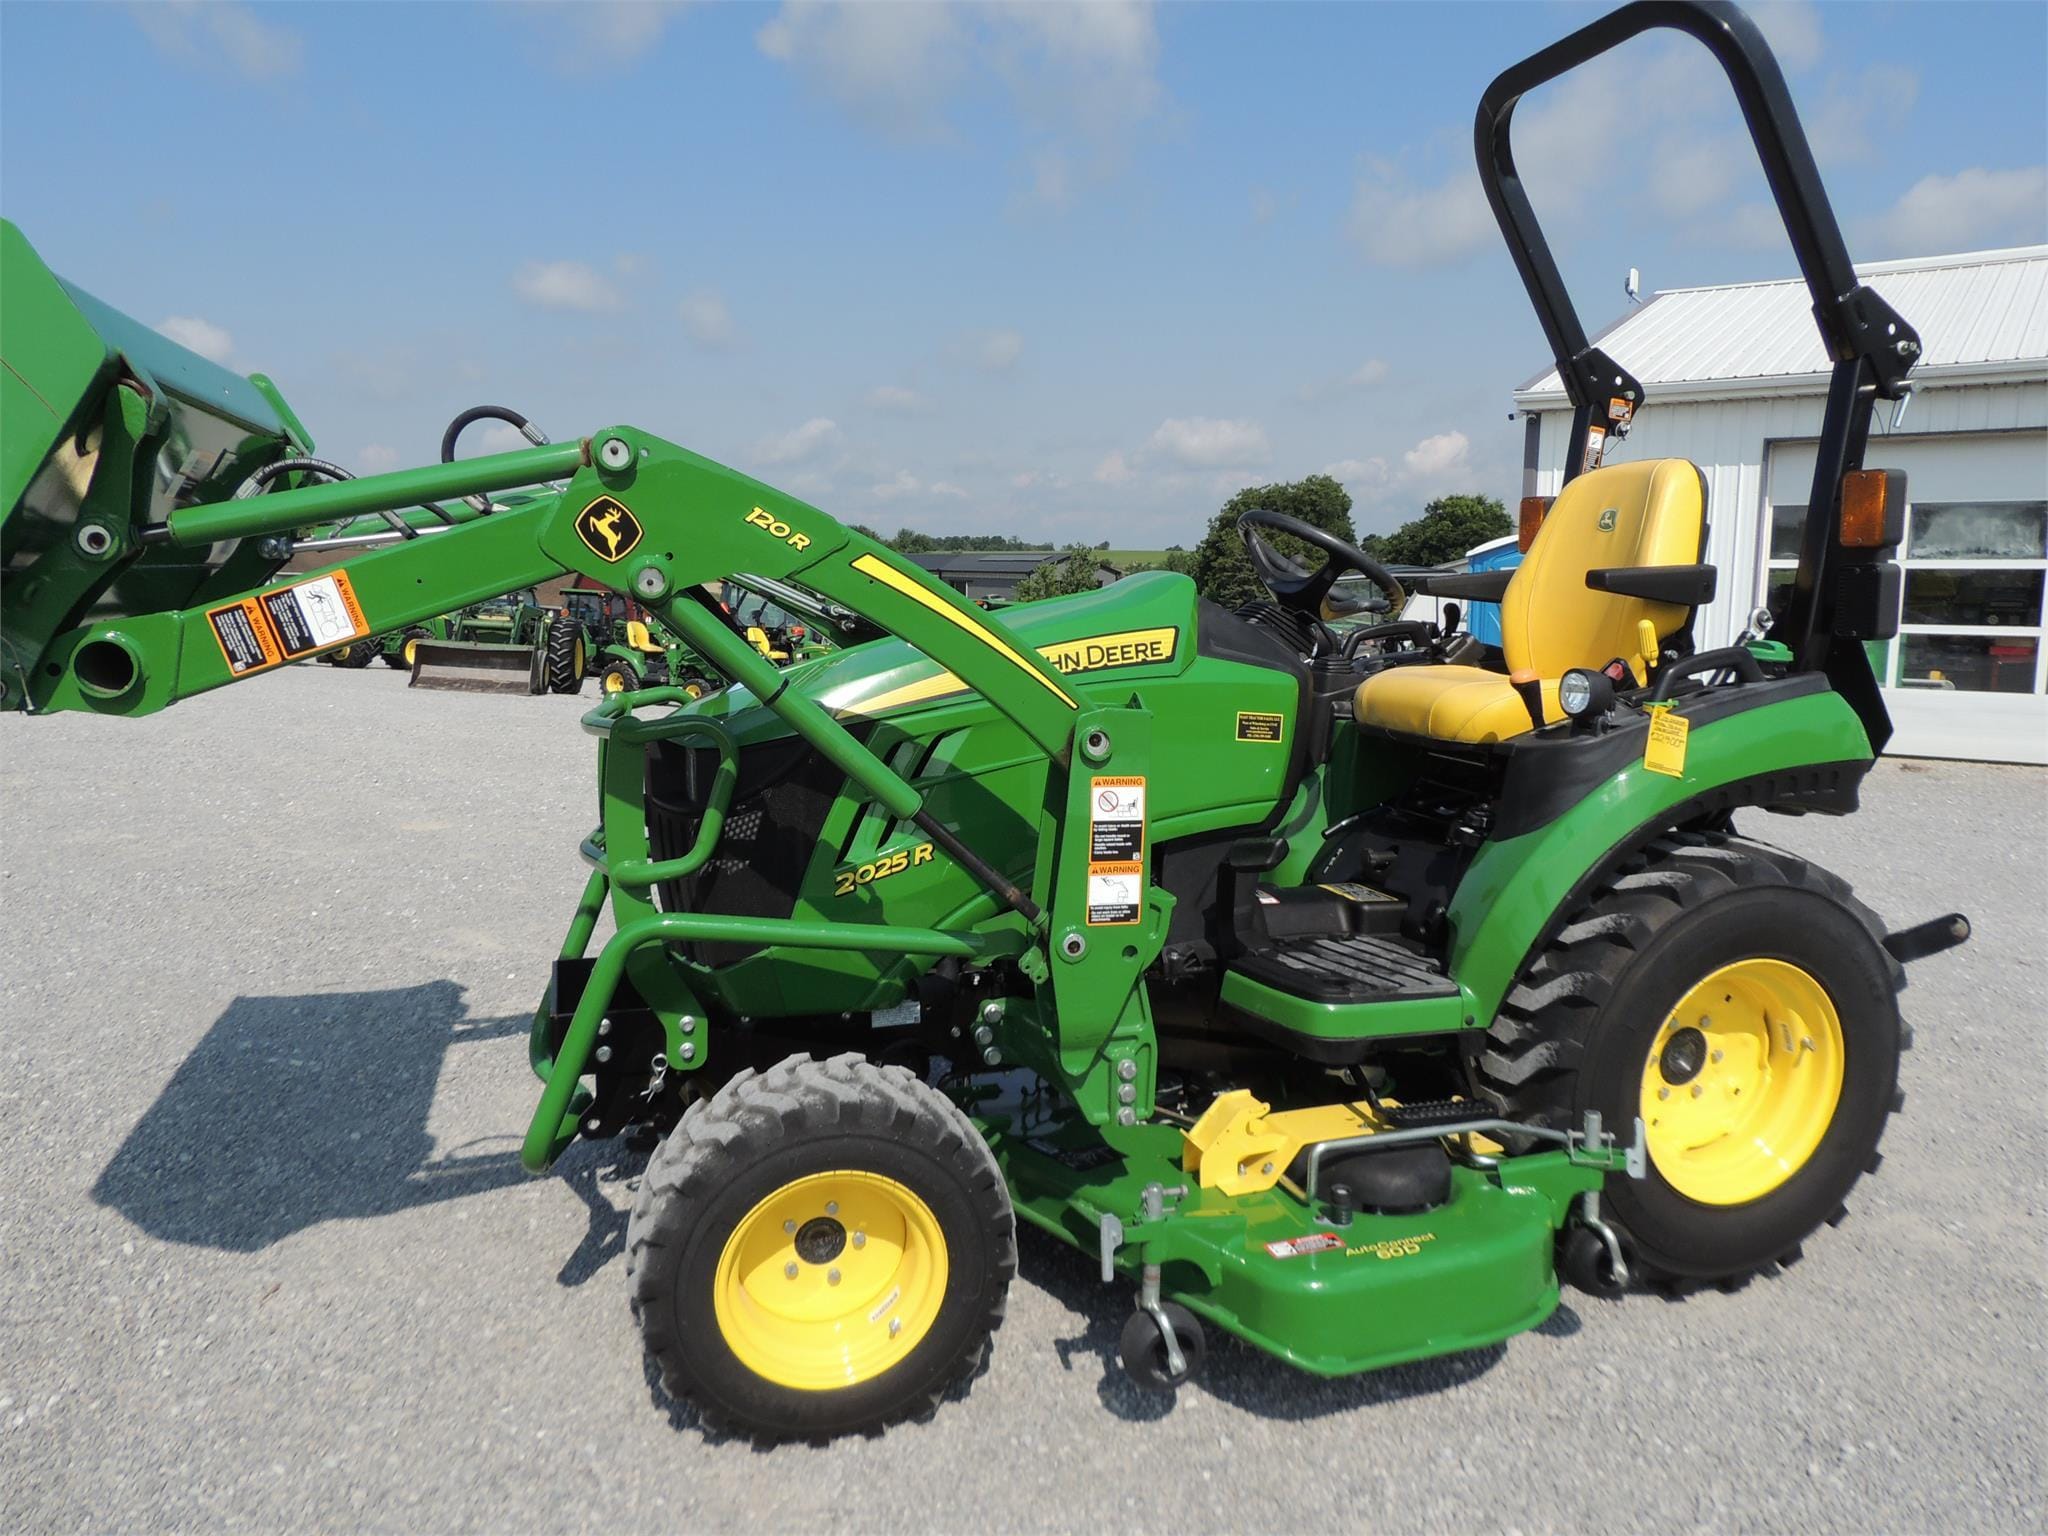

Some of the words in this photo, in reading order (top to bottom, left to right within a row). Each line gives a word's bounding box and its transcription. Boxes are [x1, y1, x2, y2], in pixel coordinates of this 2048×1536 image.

[744, 506, 791, 538] 120
[787, 532, 811, 552] R
[342, 587, 363, 628] WARNING
[252, 617, 275, 657] WARNING
[1047, 652, 1080, 669] HN
[1087, 641, 1163, 665] DEERE
[1102, 778, 1143, 787] WARNING
[834, 850, 909, 897] 2025
[913, 842, 935, 865] R
[1099, 865, 1140, 874] WARNING
